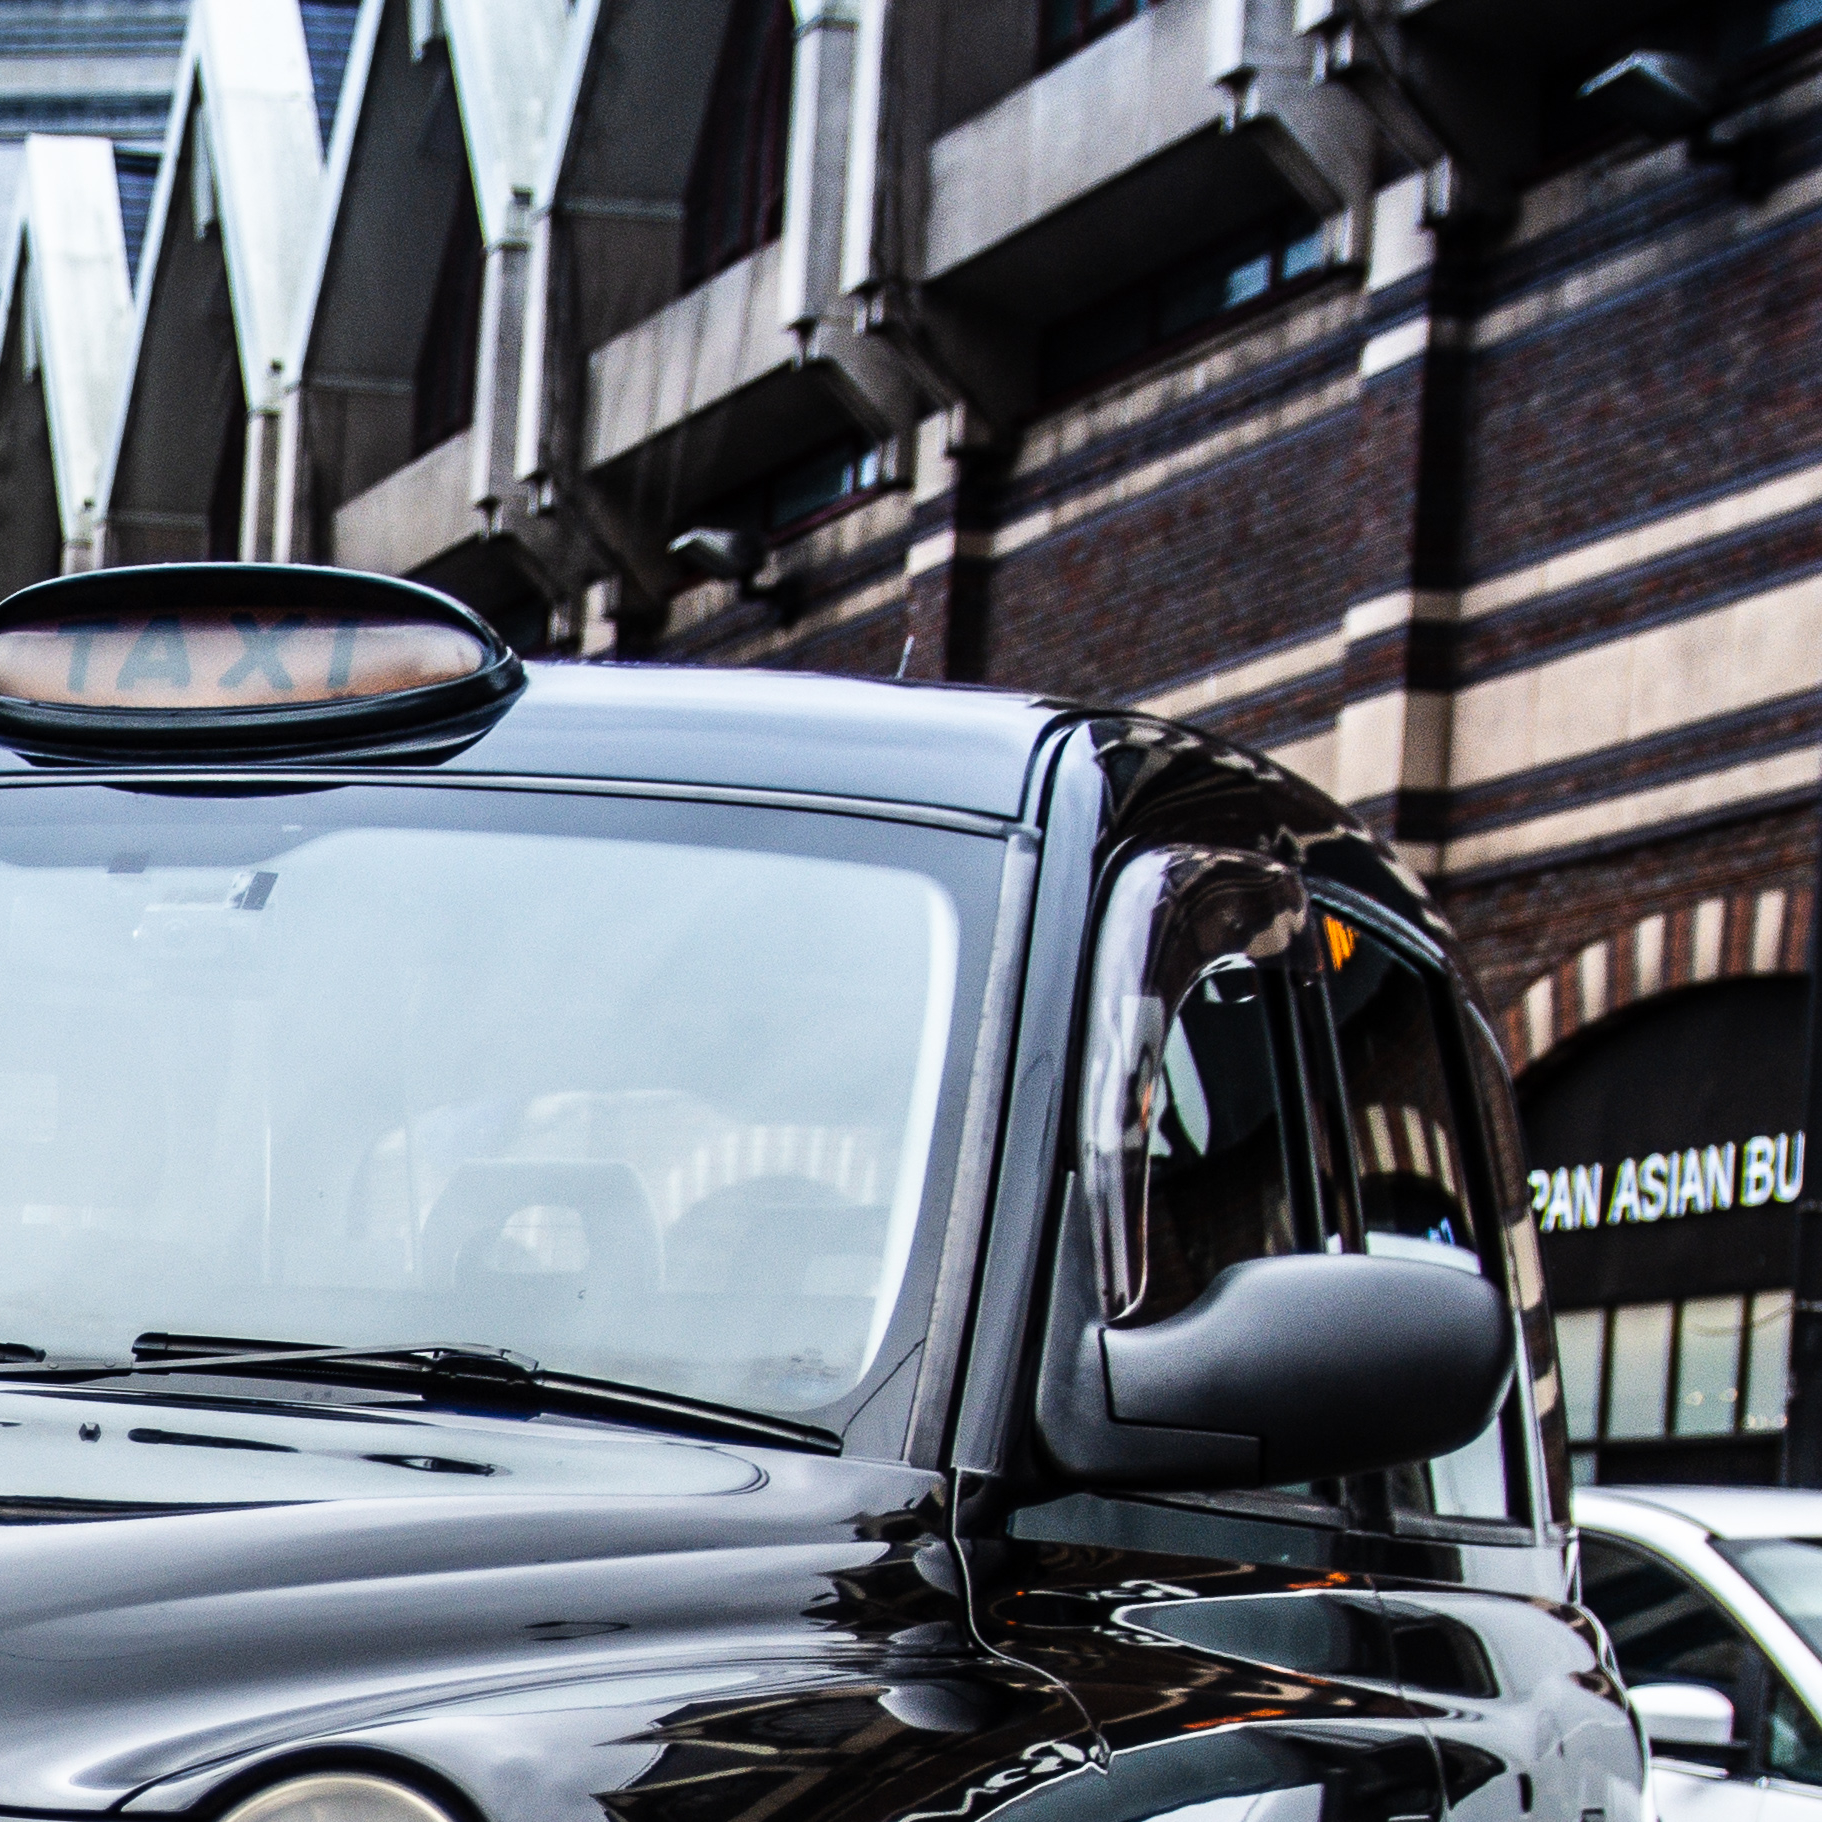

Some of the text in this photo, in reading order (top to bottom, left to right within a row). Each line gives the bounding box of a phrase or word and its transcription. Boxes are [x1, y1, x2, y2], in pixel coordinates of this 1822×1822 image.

[59, 612, 360, 693] TAXI
[1527, 1130, 1806, 1232] PAN ASIAN BU
